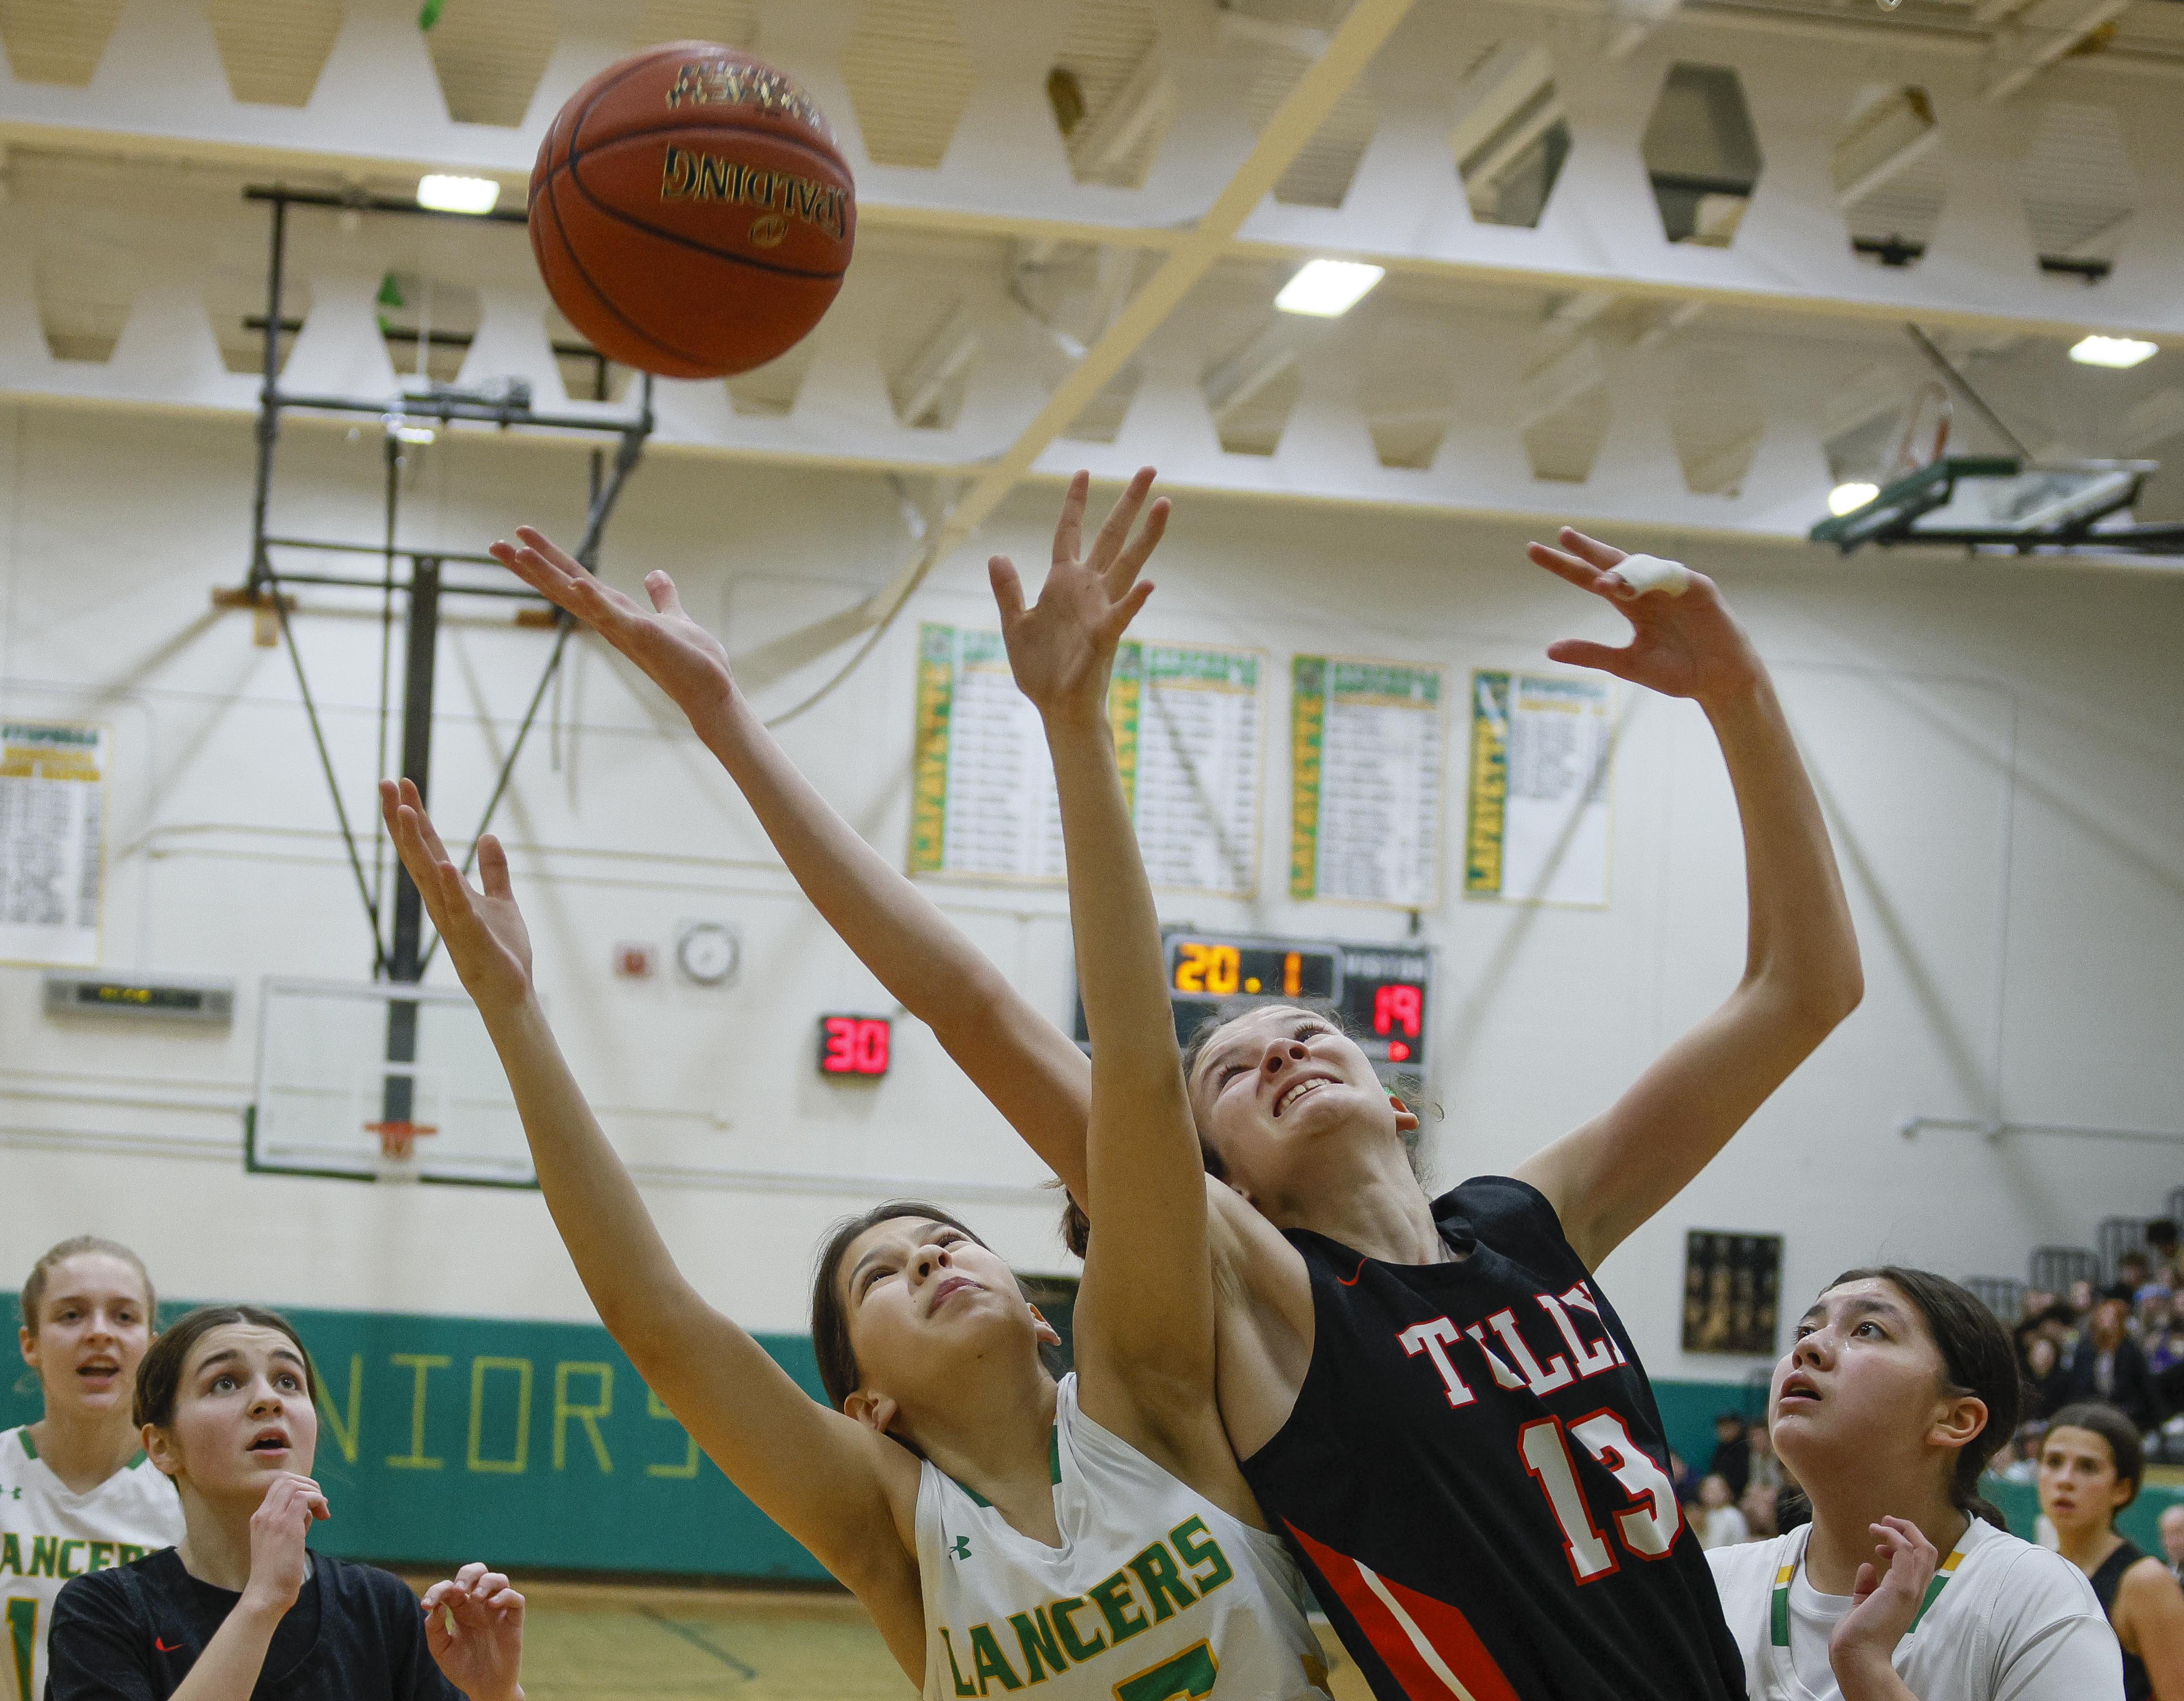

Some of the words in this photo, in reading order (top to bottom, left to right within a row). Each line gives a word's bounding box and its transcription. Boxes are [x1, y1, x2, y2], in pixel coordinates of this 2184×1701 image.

[661, 144, 845, 240] SPALDING
[823, 1017, 890, 1074] 30
[1517, 1407, 1685, 1586] 13
[939, 1513, 1234, 1698] LANCERS
